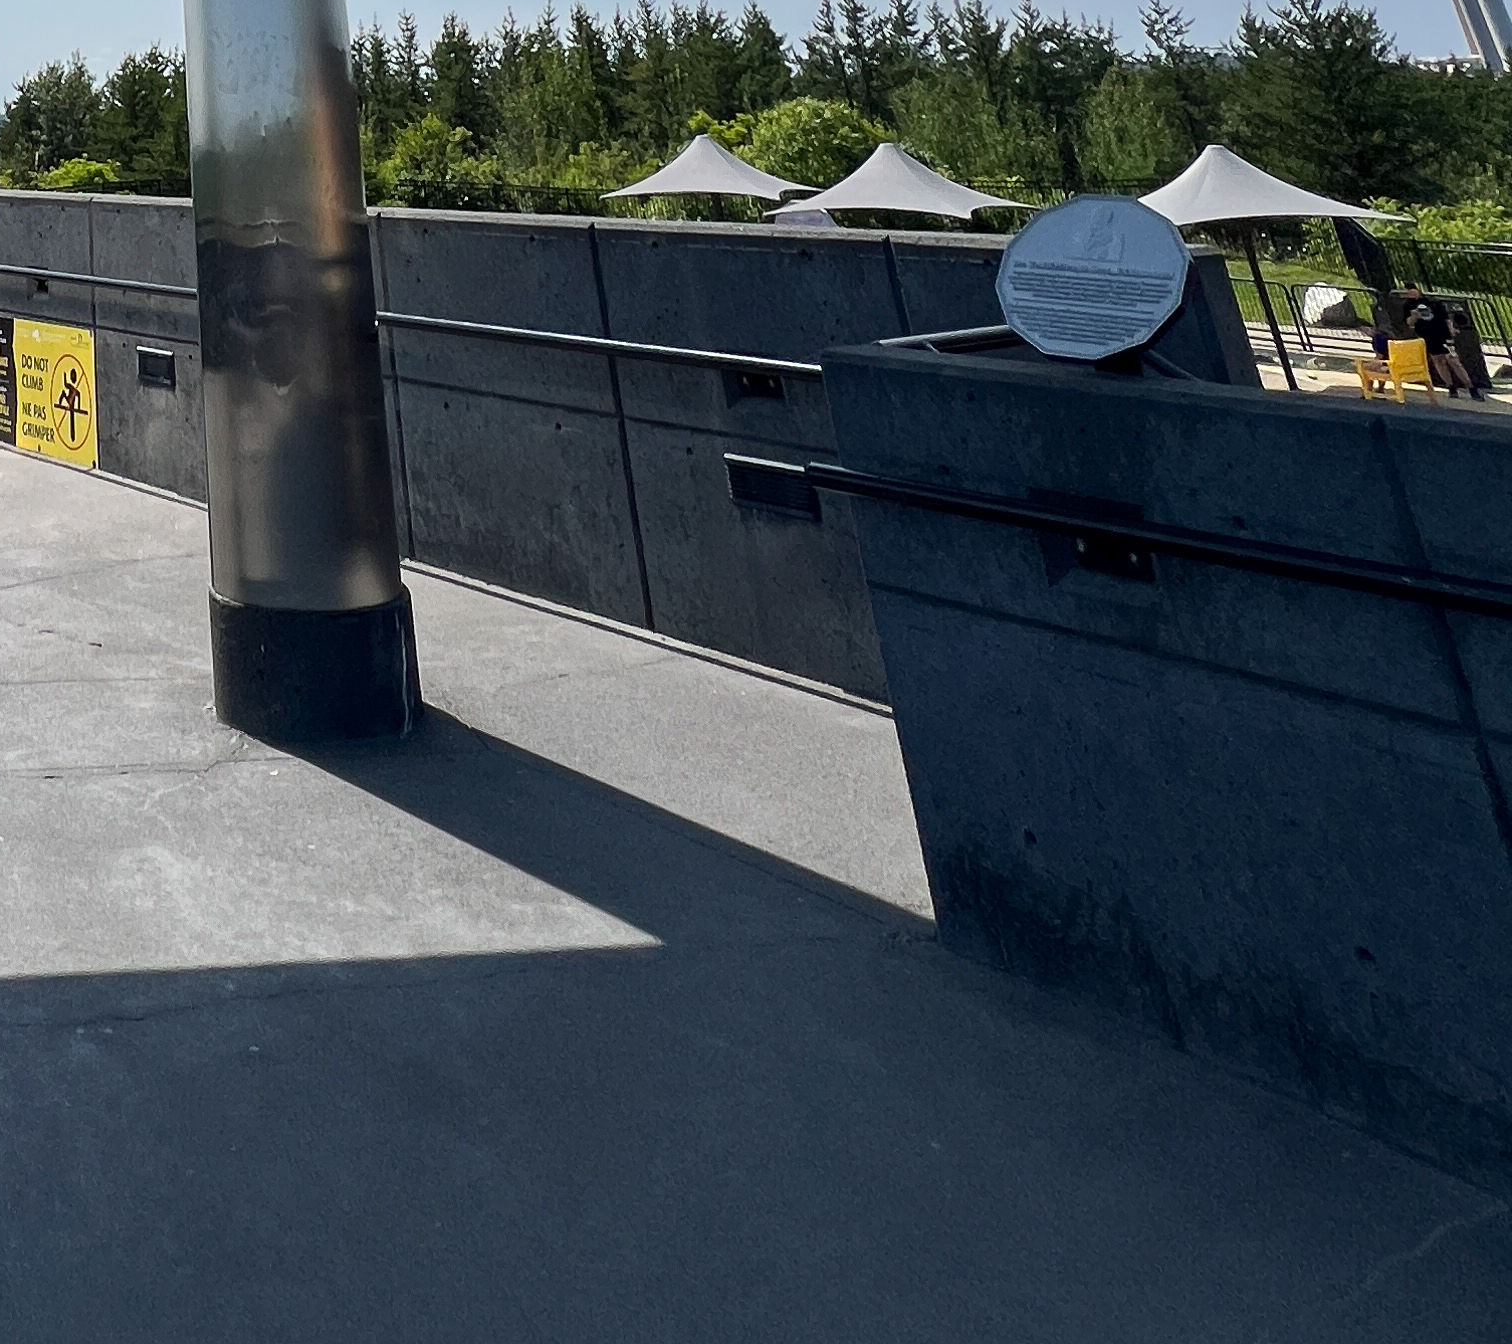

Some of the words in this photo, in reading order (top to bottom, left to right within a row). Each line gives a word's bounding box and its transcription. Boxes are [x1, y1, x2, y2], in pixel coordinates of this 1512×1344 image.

[21, 354, 33, 369] DO
[34, 356, 49, 372] NOT
[21, 373, 44, 392] CLIMB
[22, 401, 32, 418] NE
[33, 403, 46, 421] PAS
[22, 421, 55, 443] GRIMPER
